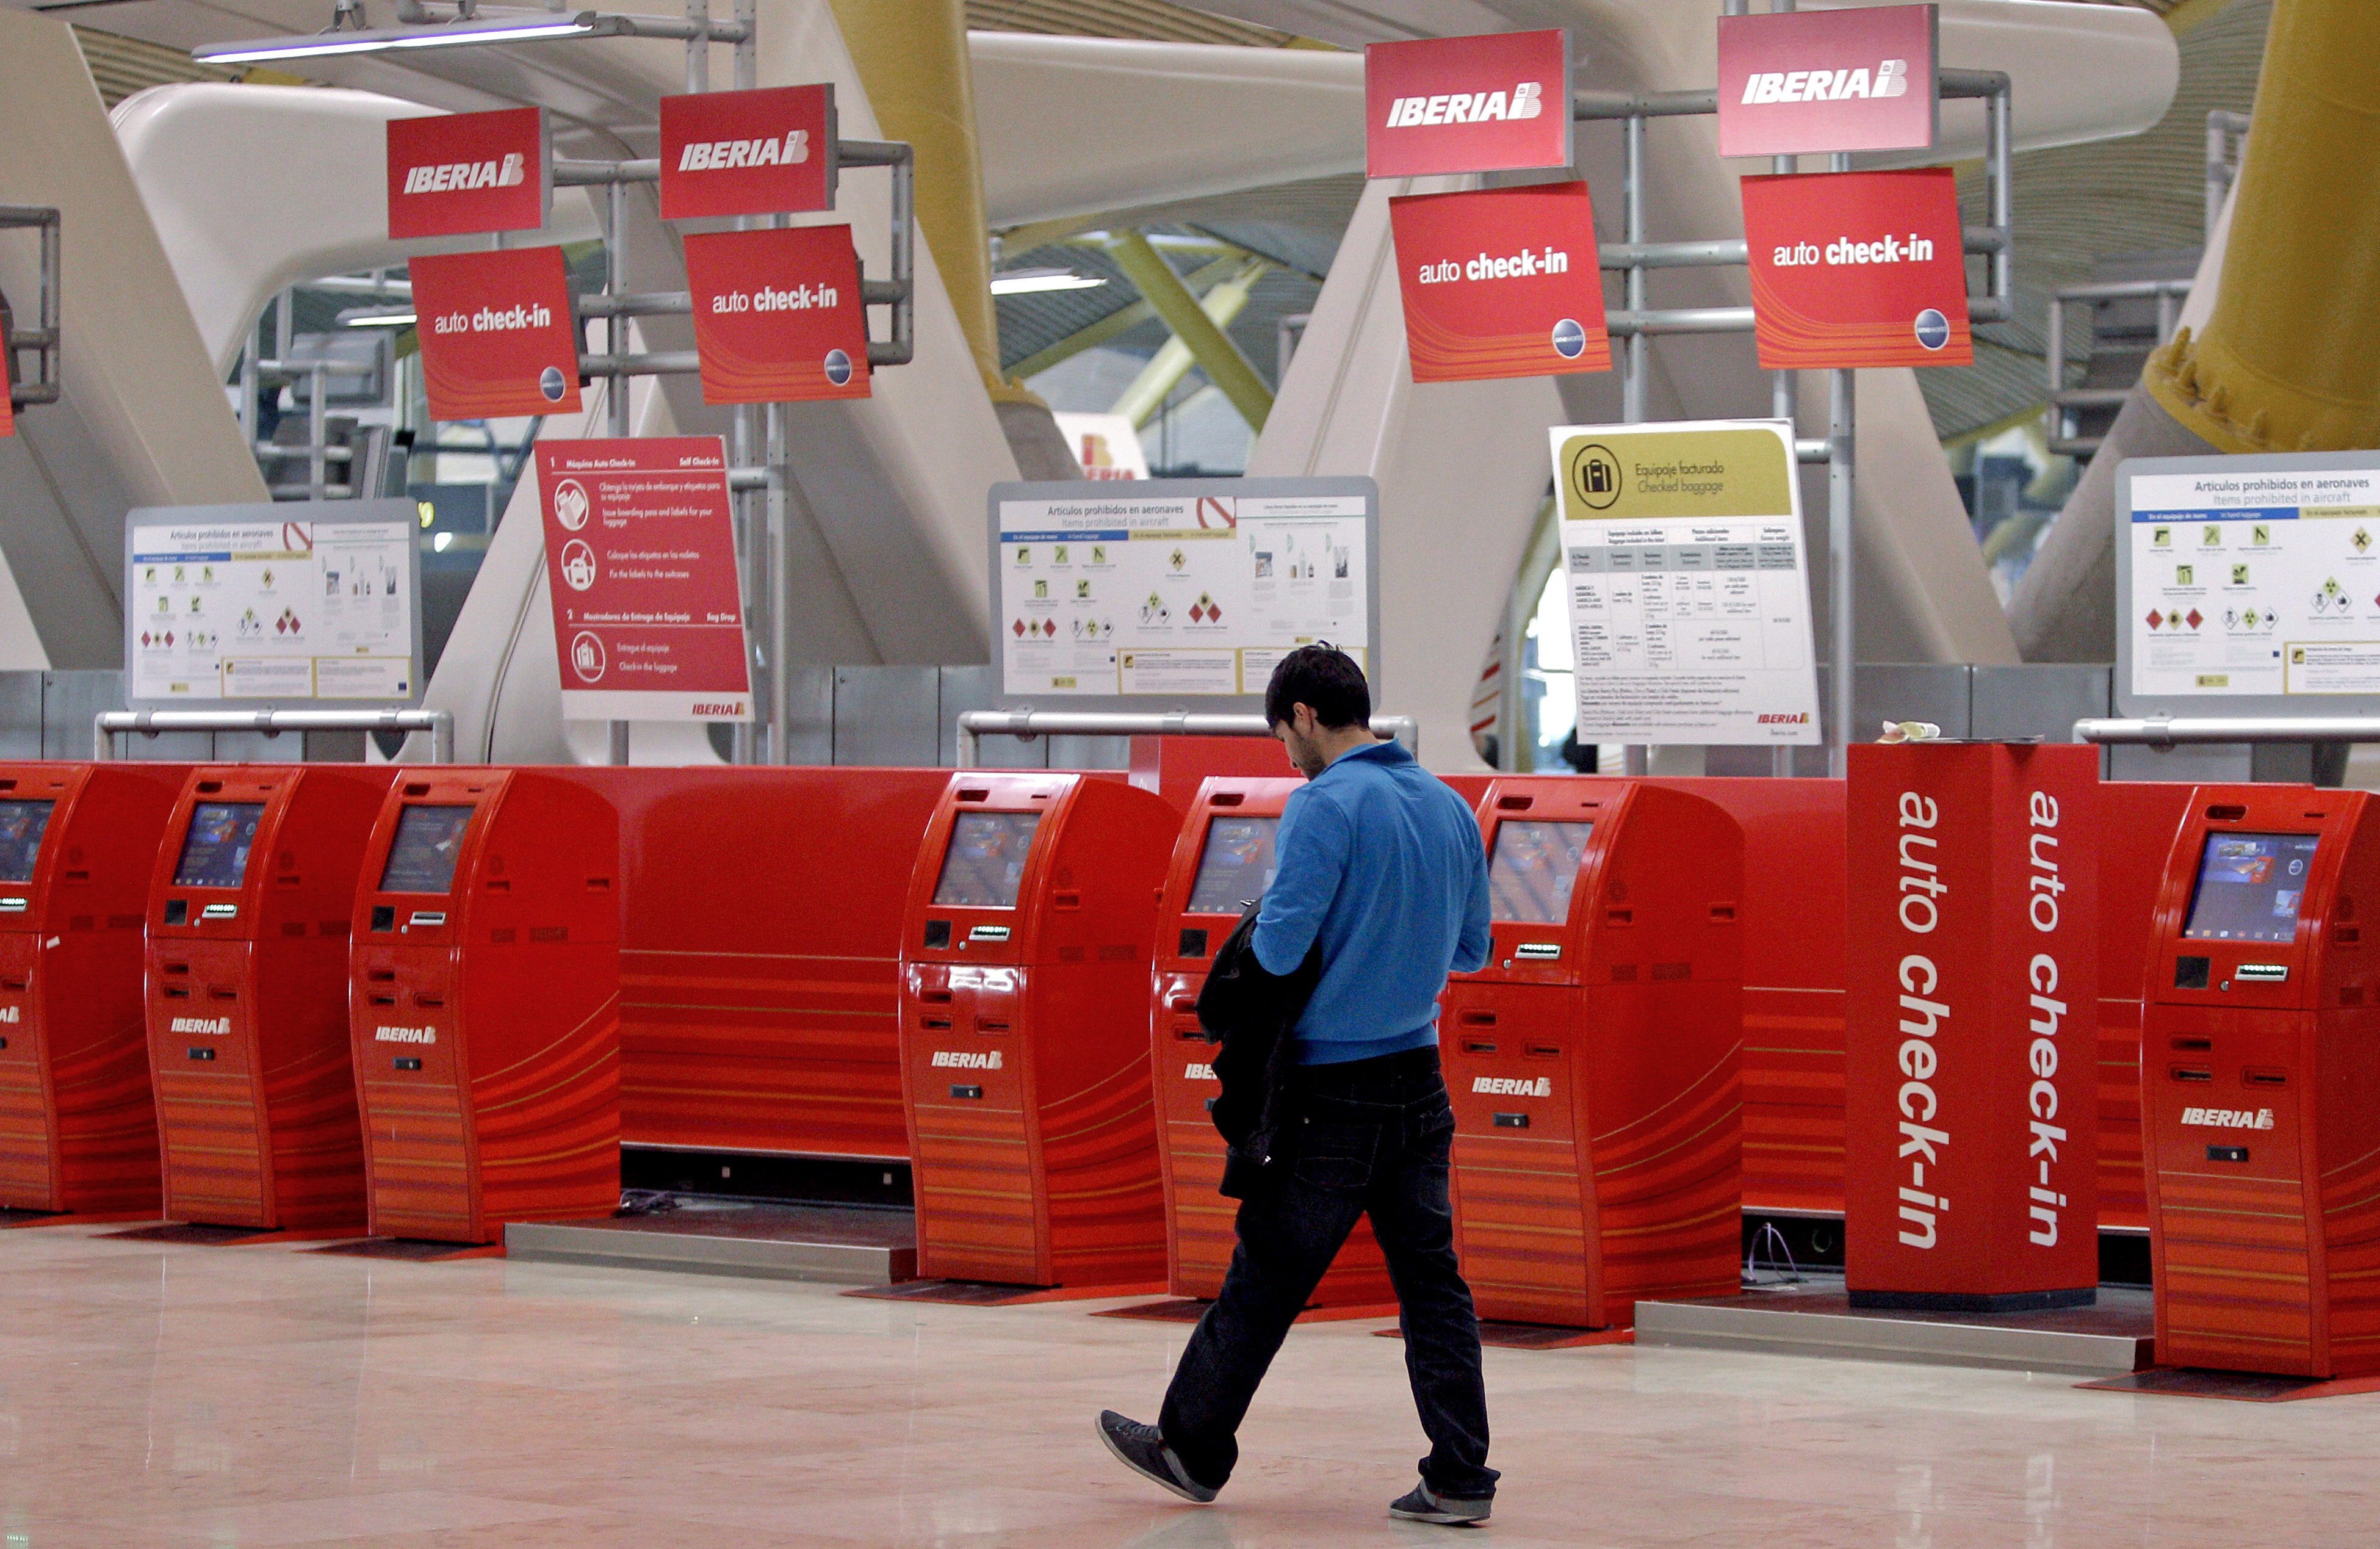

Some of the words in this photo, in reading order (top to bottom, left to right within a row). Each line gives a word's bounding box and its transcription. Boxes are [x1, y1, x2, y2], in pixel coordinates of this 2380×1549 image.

[1741, 67, 1869, 104] IBERIA
[1387, 90, 1510, 127] IBERIA
[679, 138, 779, 172] IBERIA
[403, 161, 496, 194] IBERIA
[1773, 241, 1820, 267] auto
[1825, 233, 1933, 265] check-in
[1419, 259, 1461, 284] auto
[1466, 246, 1568, 280] check-in
[712, 291, 749, 313] auto
[754, 283, 837, 311] check-in
[435, 312, 469, 334] auto
[472, 303, 550, 331] check-in
[1635, 462, 1676, 479] Equipaje
[1679, 460, 1724, 474] facturado
[1638, 477, 1678, 493] Checked
[1681, 477, 1723, 495] baggage
[2243, 479, 2298, 493] prohibidos
[2301, 481, 2313, 489] en
[2317, 478, 2370, 489] aeronaves
[2213, 494, 2241, 505] Items
[2244, 493, 2298, 507] prohibited
[2301, 493, 2310, 502] in
[2313, 493, 2351, 503] aircraft
[1084, 505, 1128, 518] prohibidos
[1130, 507, 1140, 515] en
[1142, 505, 1184, 514] aeronaves
[1062, 519, 1083, 528] Items
[1085, 518, 1127, 530] prohibited
[1130, 518, 1139, 526] in
[1141, 517, 1169, 527] aircraft
[567, 609, 574, 619] 2
[692, 704, 734, 715] IBERIA
[1758, 714, 1798, 724] IBERIA
[1899, 792, 1947, 933] auto
[2030, 790, 2065, 932] auto
[171, 1017, 218, 1034] IBERIA
[375, 1027, 422, 1042] IBERIA
[931, 1051, 987, 1069] IBERIA
[1472, 1077, 1534, 1096] IBERIA
[1899, 955, 1950, 1249] check-in
[2030, 954, 2067, 1246] check-in
[2181, 1107, 2254, 1128] IBERIA
